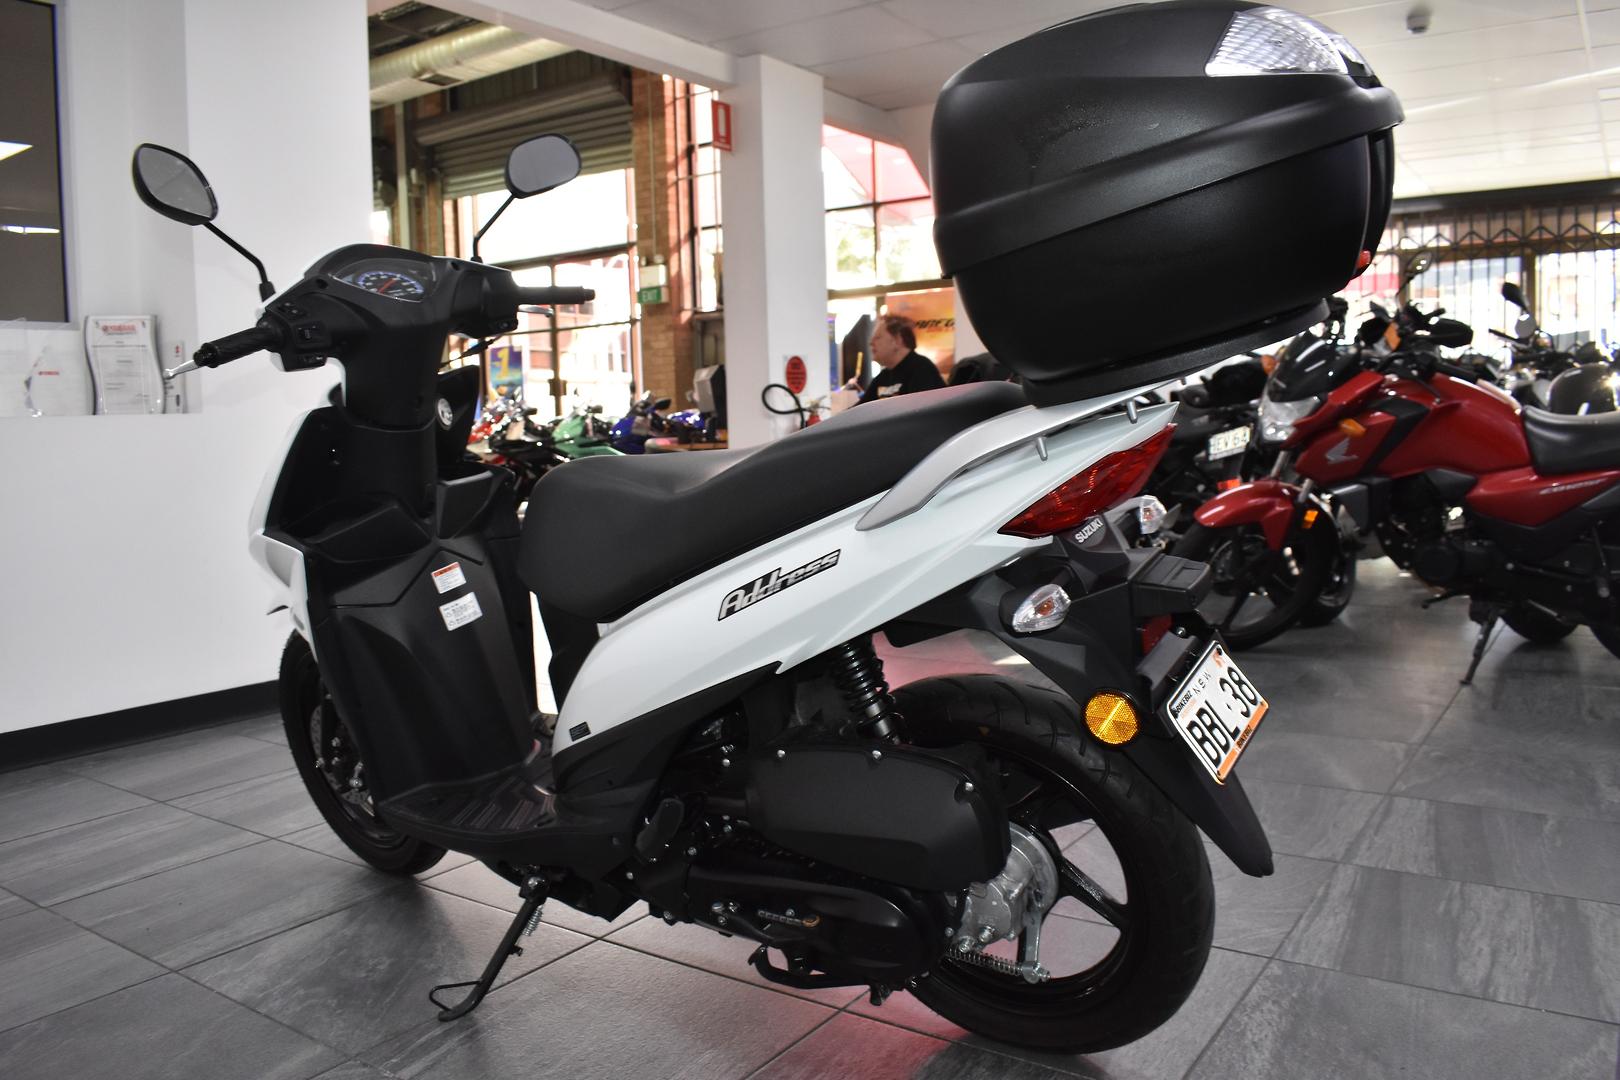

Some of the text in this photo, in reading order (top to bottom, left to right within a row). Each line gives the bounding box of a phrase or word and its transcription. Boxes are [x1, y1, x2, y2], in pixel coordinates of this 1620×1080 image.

[642, 289, 657, 302] EXIT
[1074, 517, 1104, 543] SUZUKI
[718, 549, 841, 621] Address
